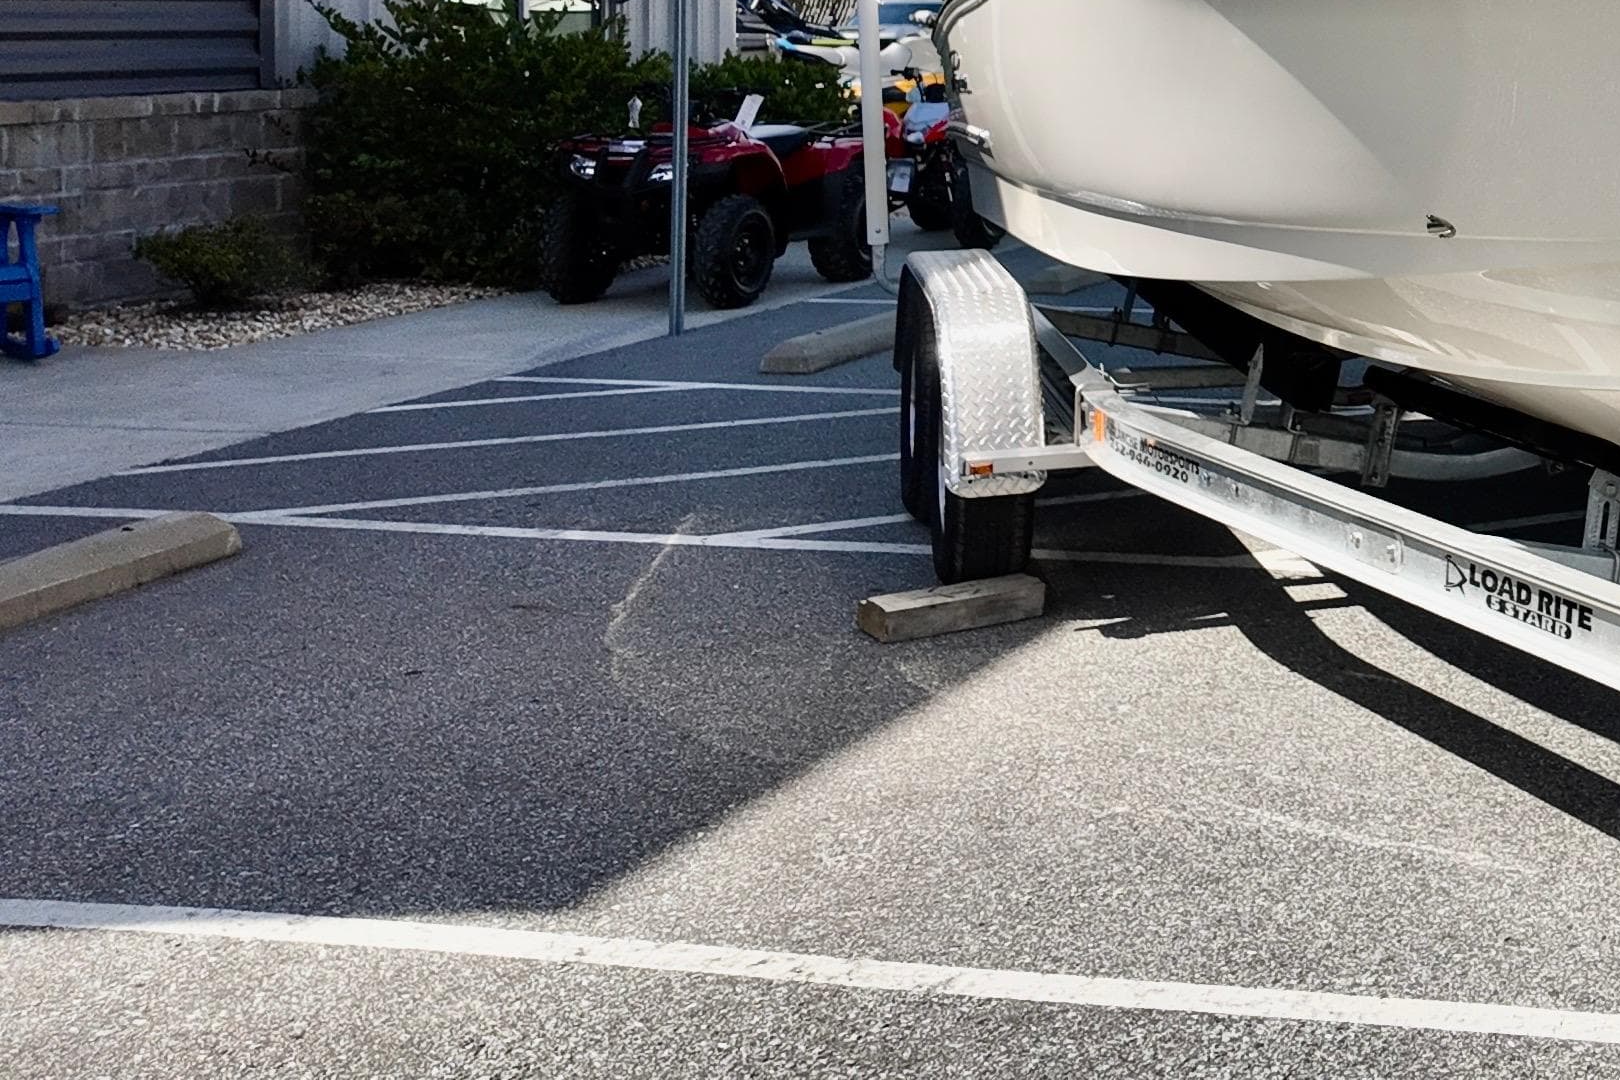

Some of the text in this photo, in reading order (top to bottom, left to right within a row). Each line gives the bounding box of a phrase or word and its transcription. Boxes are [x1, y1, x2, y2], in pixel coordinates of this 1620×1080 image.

[1470, 563, 1593, 632] LOAD RITE
[1488, 595, 1569, 638] 5 STARR
